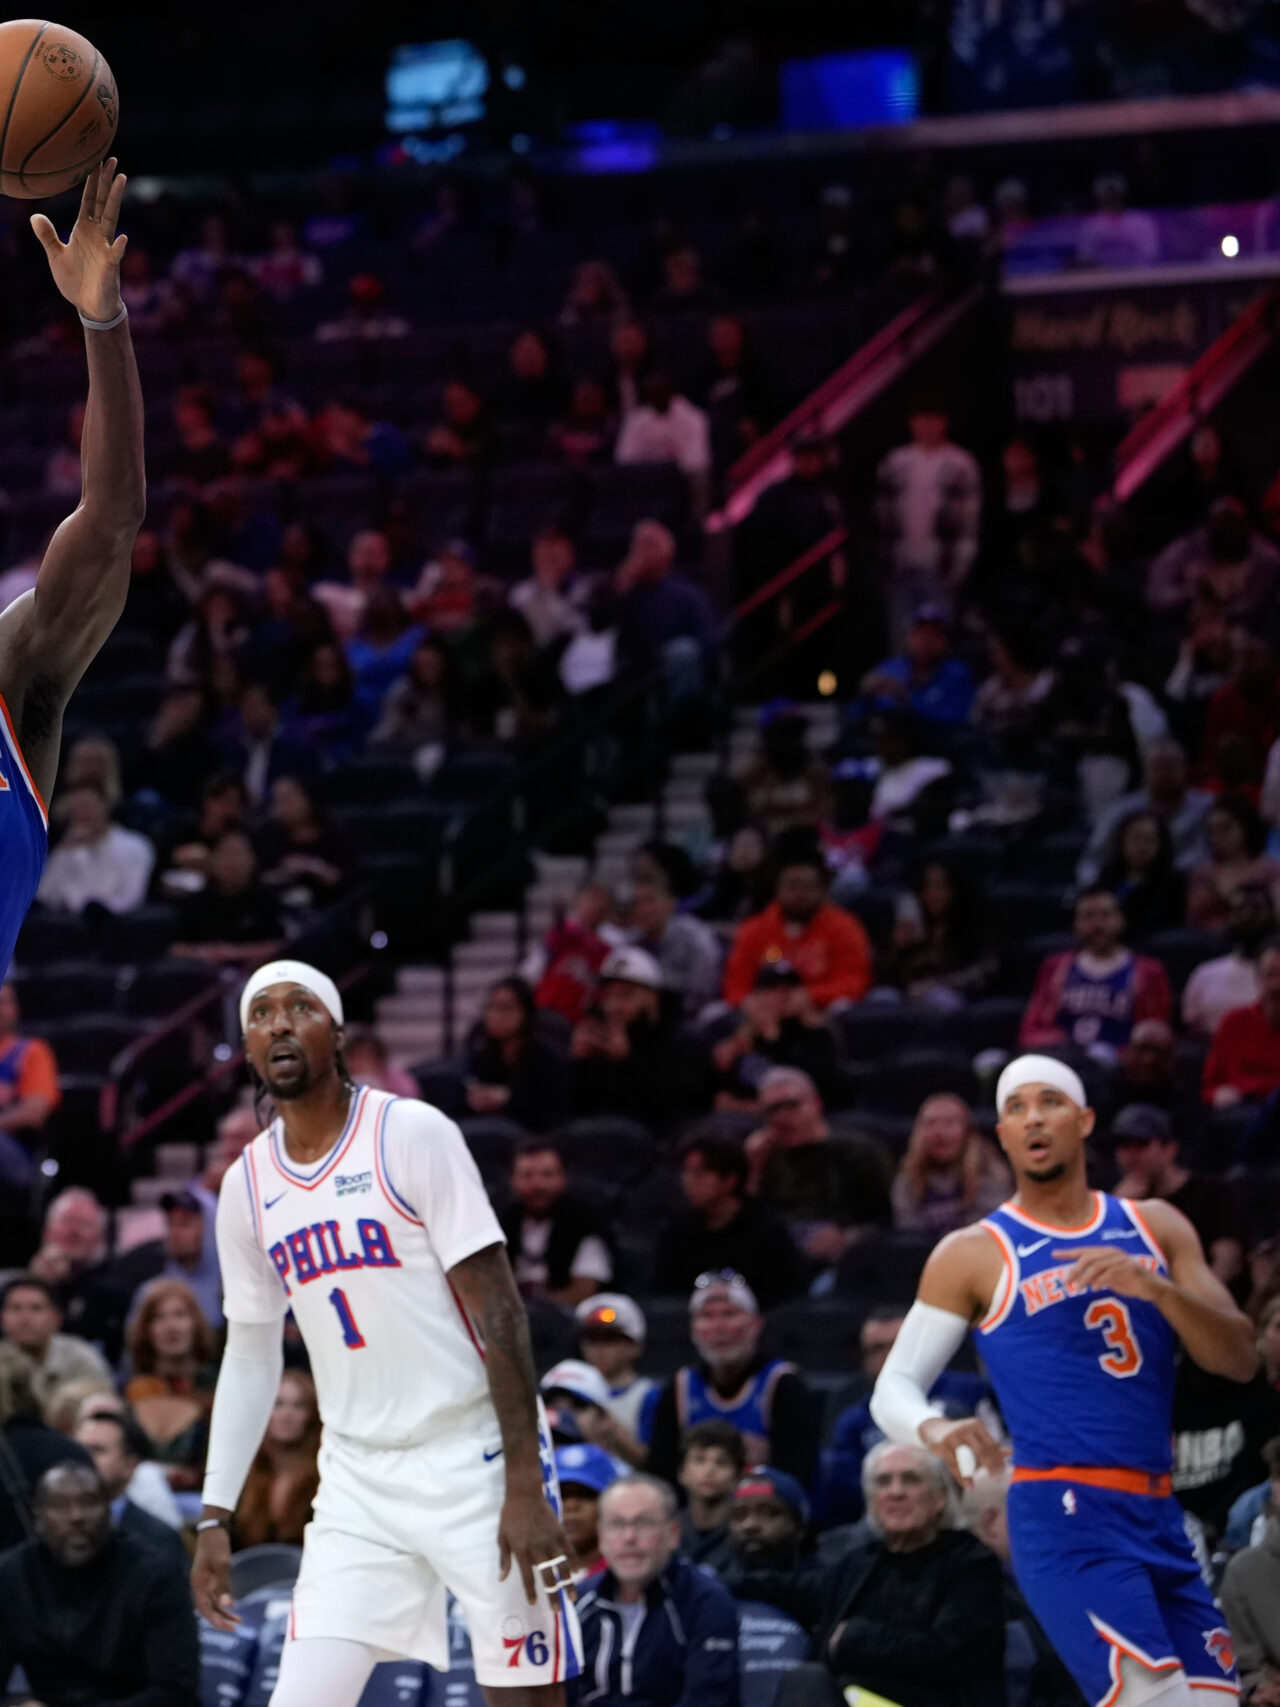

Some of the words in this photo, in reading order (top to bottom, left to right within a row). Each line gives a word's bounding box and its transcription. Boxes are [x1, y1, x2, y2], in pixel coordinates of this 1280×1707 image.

[334, 1171, 372, 1188] Bloom
[269, 1218, 402, 1297] PHILA
[329, 1287, 366, 1350] 1
[1083, 1297, 1143, 1379] 3
[502, 1631, 549, 1668] 76
